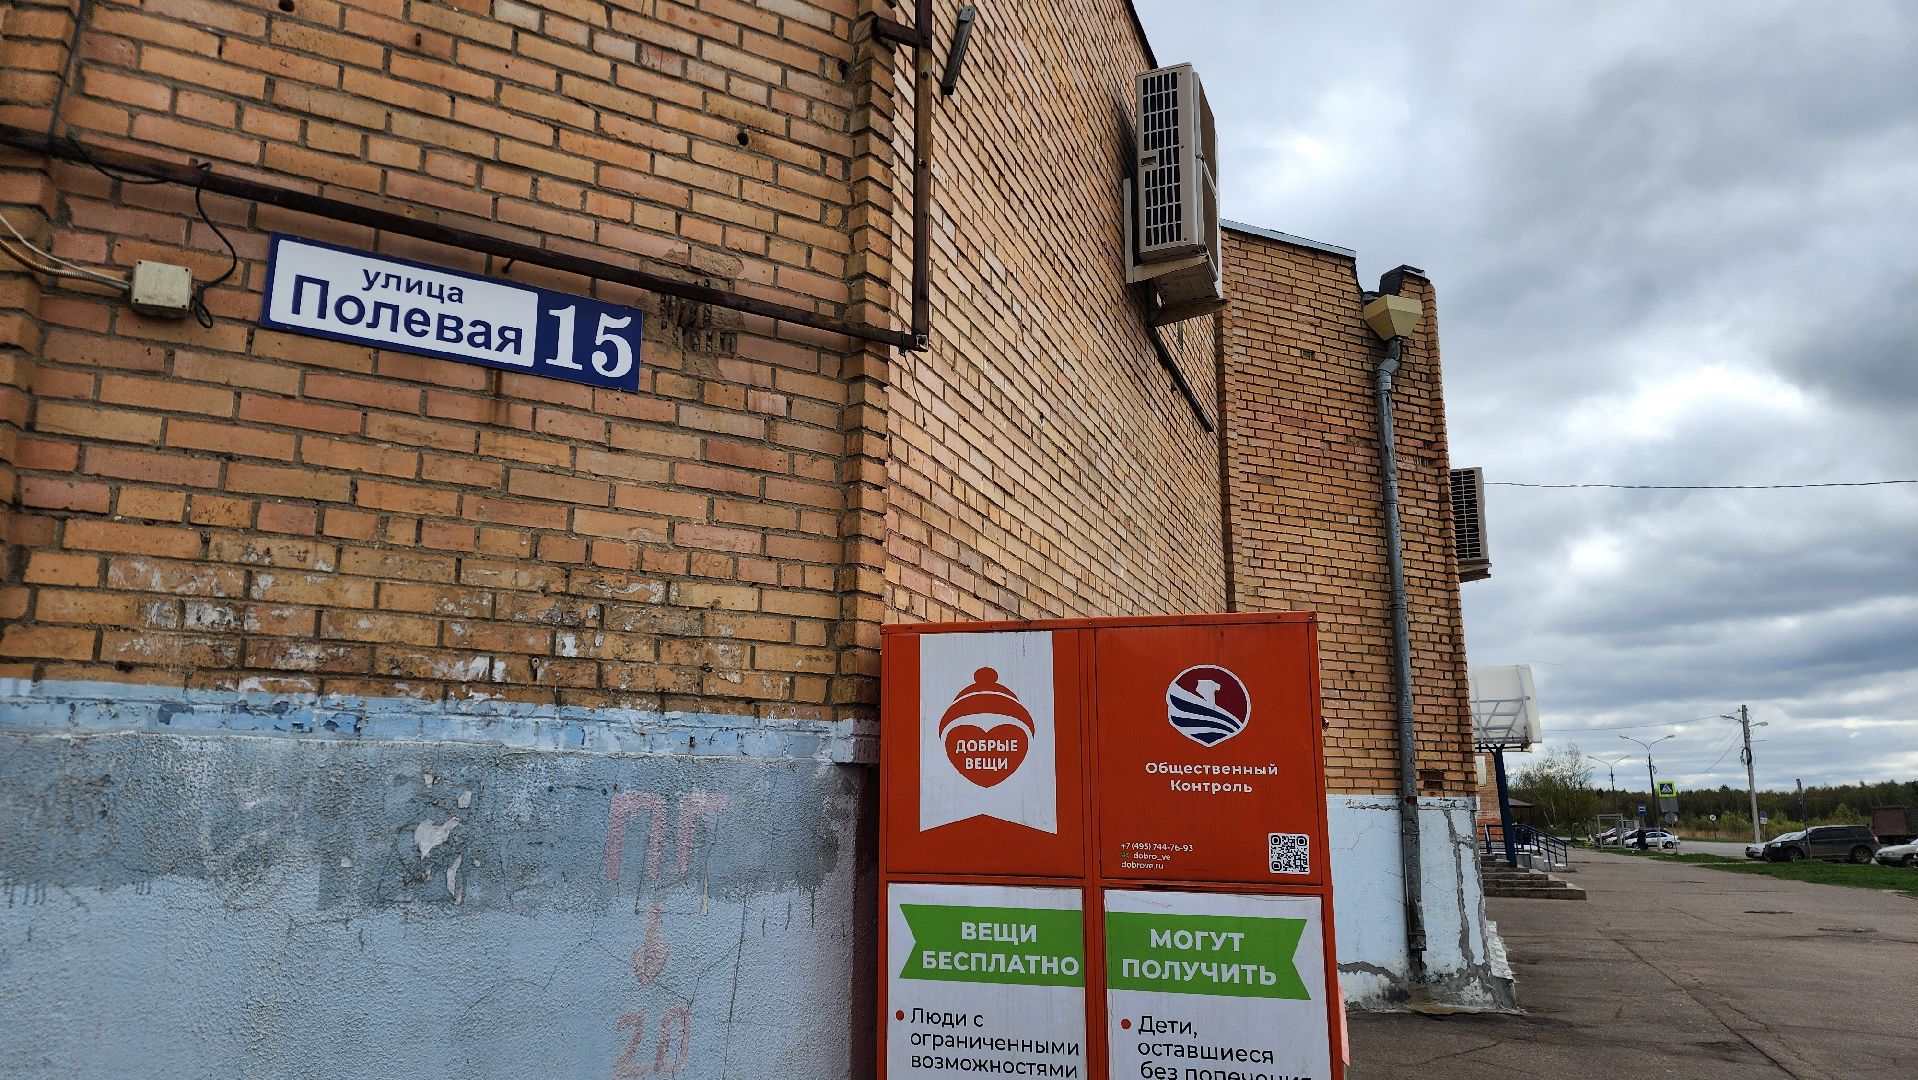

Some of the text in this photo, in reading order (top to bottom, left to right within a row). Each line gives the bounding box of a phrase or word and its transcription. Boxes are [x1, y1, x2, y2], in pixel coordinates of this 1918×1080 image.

[361, 268, 464, 304] улица
[291, 274, 523, 356] Полевая
[545, 304, 633, 378] 15
[956, 739, 1018, 754] ДОБРЫЕ
[965, 757, 1008, 771] ВЕЩИ
[1145, 761, 1279, 776] Общественный
[1170, 779, 1253, 795] Контроль
[1121, 842, 1193, 852] +7 (495) 744-76-93
[1133, 852, 1171, 861] dobro_ve
[961, 921, 1037, 945] ВЕЩИ
[1150, 928, 1245, 952] МОГУТ
[922, 950, 1080, 976] БЕСПЛАТНО
[1122, 958, 1277, 986] ПОЛУЧИТЬ
[910, 1008, 984, 1028] Люди с
[1138, 1015, 1198, 1038] Дети,
[910, 1032, 1079, 1056] ограниченными
[1138, 1042, 1274, 1064] оставшиеся
[911, 1055, 1078, 1079] возможностями
[1140, 1061, 1178, 1080] без
